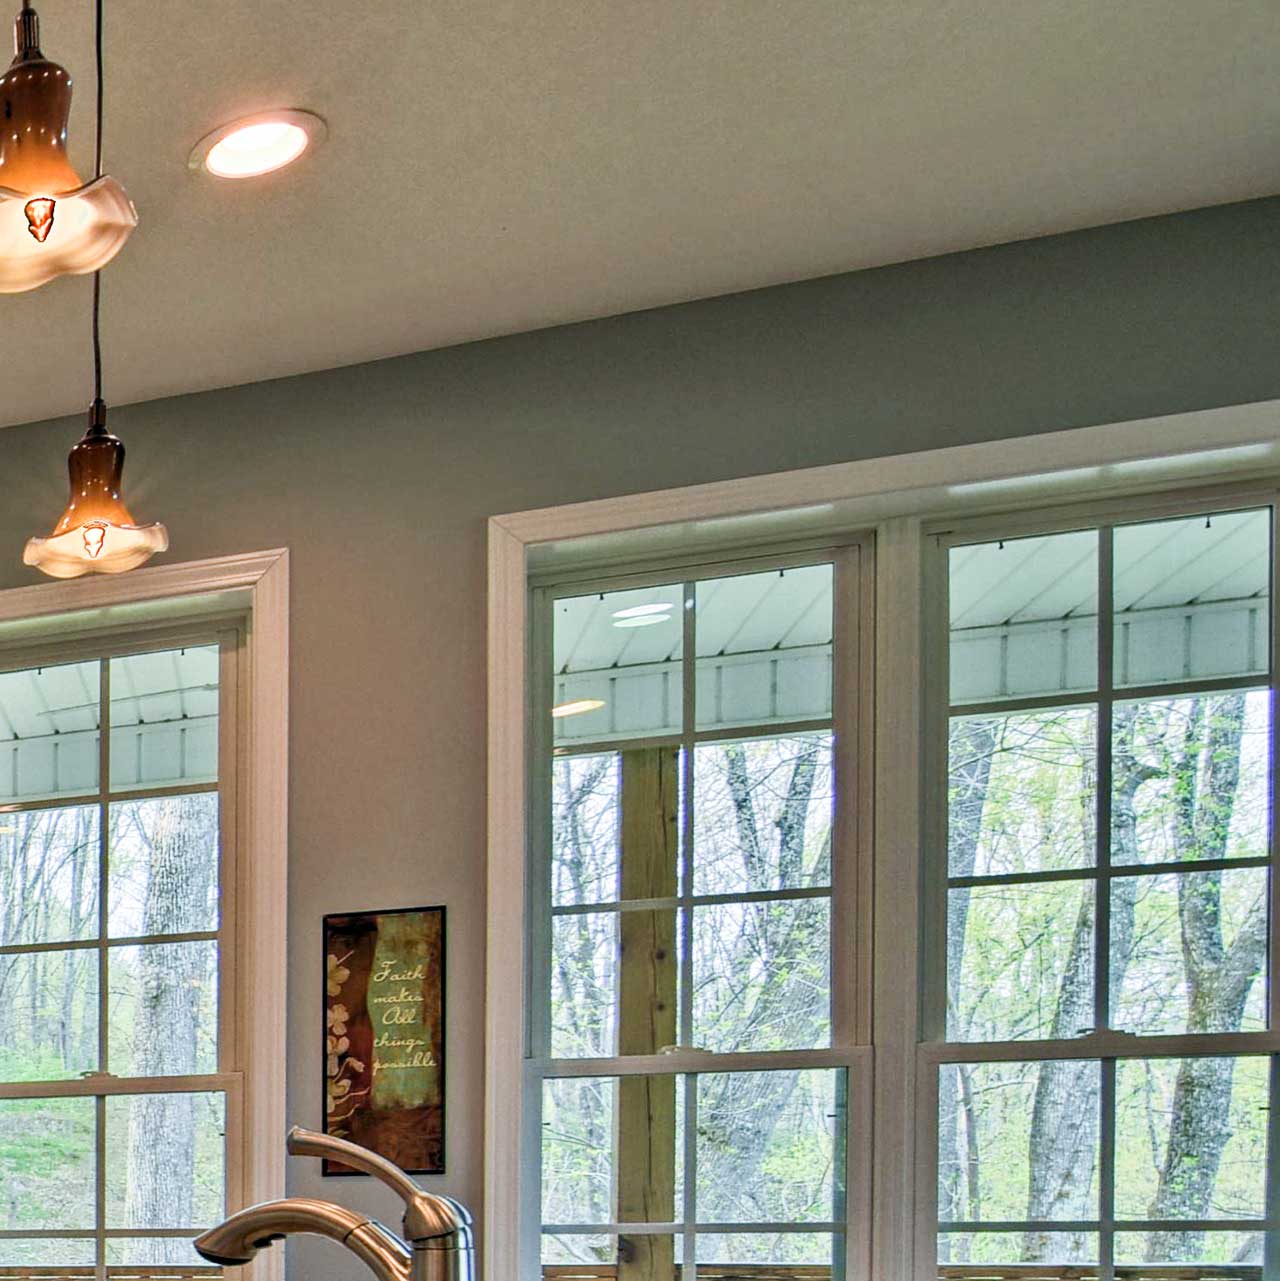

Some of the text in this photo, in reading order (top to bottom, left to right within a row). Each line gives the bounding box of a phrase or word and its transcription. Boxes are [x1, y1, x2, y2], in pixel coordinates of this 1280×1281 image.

[374, 960, 426, 982] Faith
[374, 987, 424, 1004] makes
[382, 1006, 417, 1025] All
[374, 1032, 425, 1053] things
[371, 1051, 437, 1077] possible
